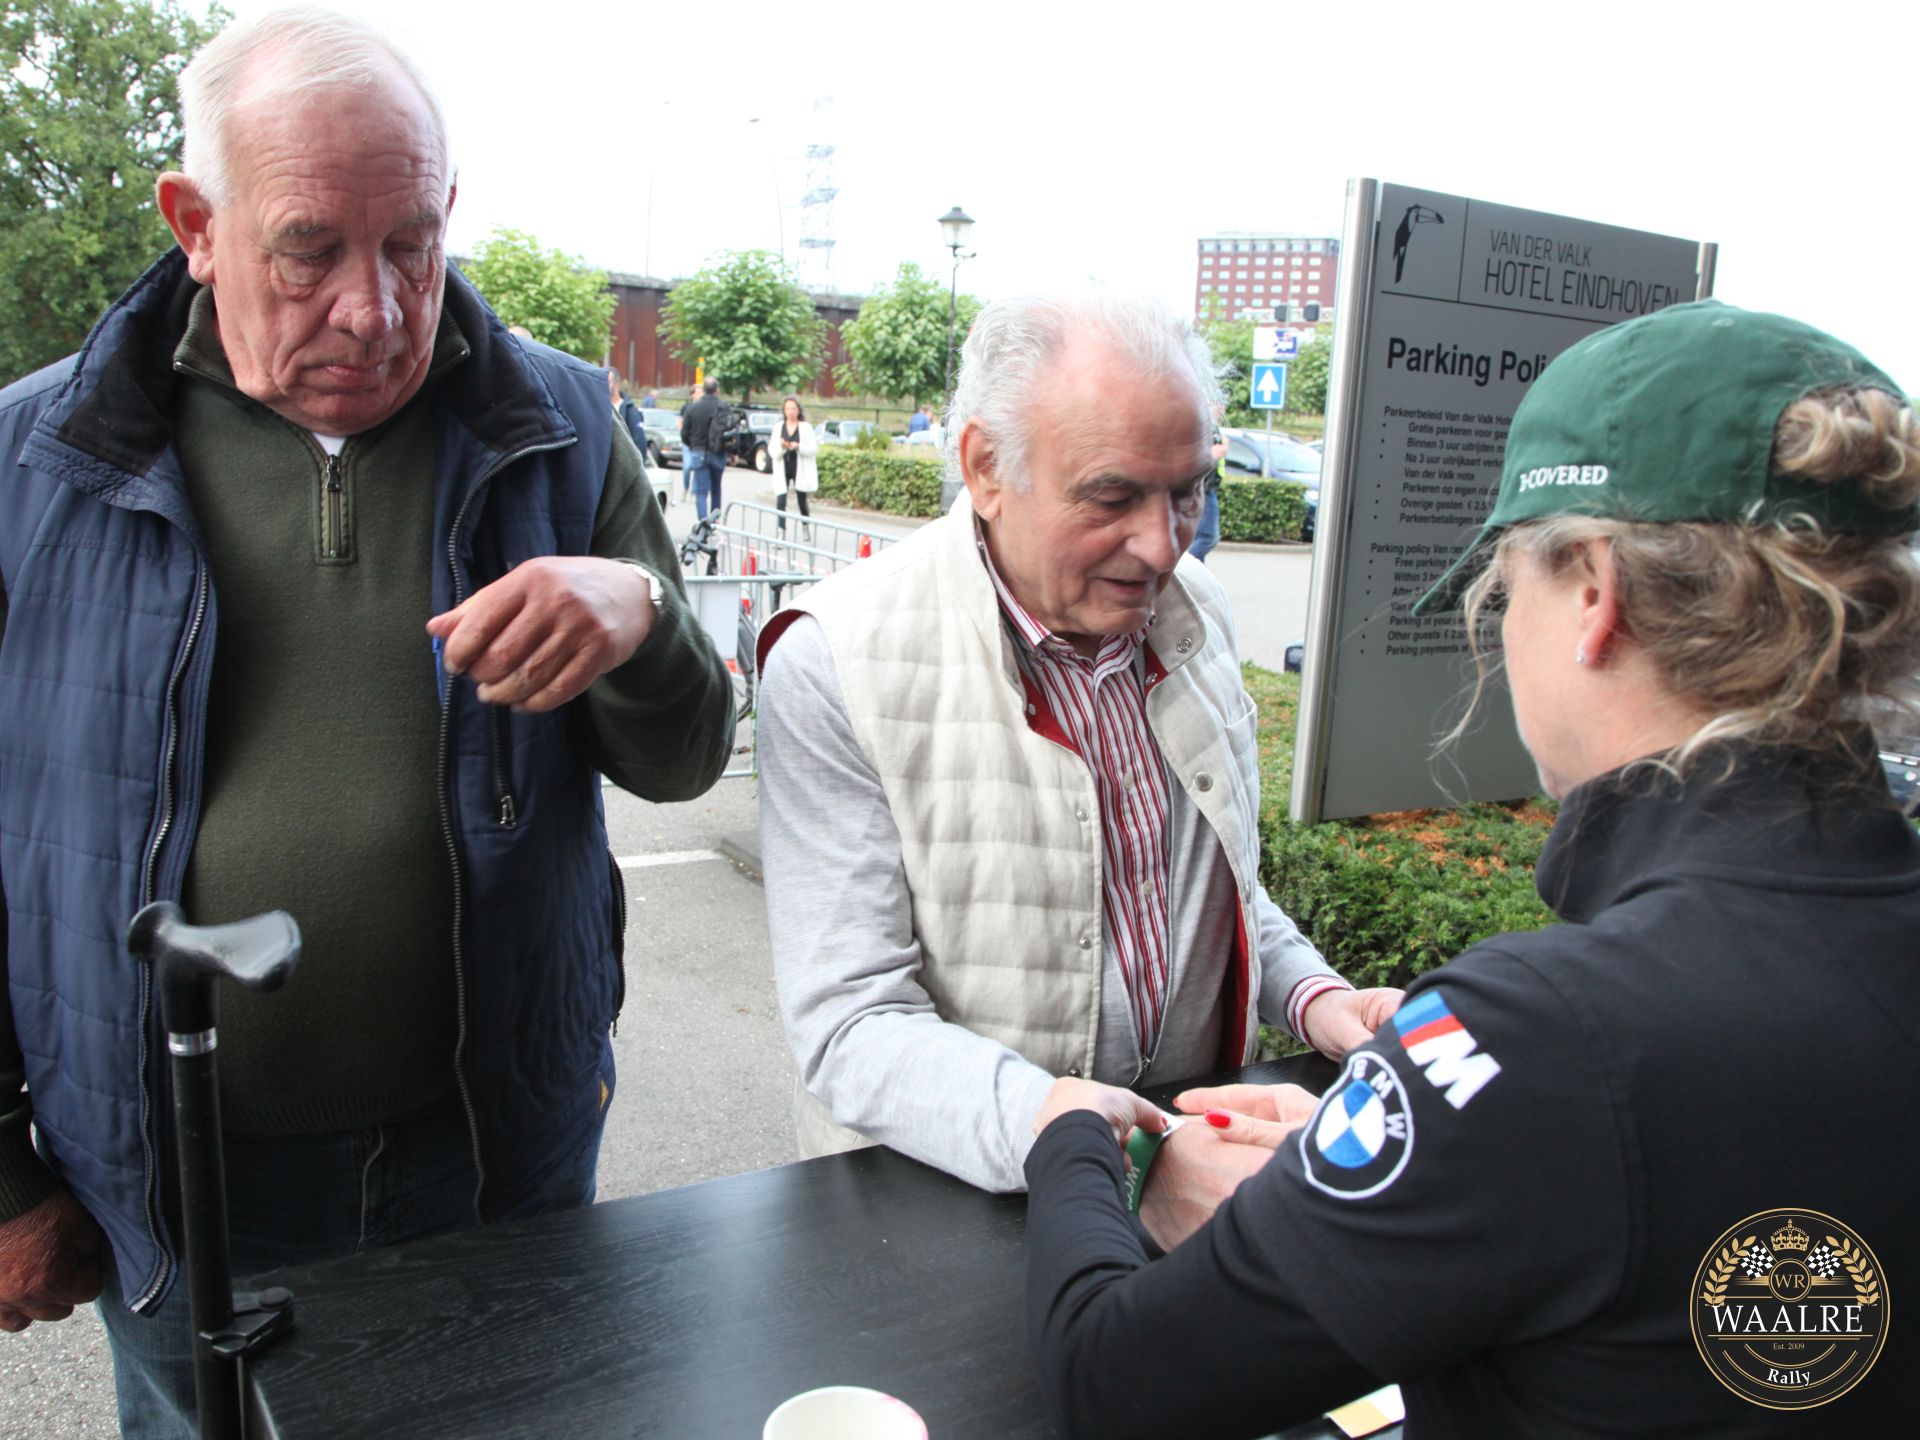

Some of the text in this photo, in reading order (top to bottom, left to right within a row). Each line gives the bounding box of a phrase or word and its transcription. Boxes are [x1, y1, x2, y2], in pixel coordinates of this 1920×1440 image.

[1491, 229, 1592, 267] VAN DER VALK
[1484, 258, 1555, 302] HOTEL
[1387, 337, 1491, 387] Parking
[1384, 405, 1443, 421] Parkeerbeleid
[1445, 410, 1460, 422] Van
[1462, 412, 1475, 423] der
[1477, 413, 1493, 425] Valk
[1408, 422, 1434, 434] Gratis
[1436, 423, 1473, 437] parkeren
[1474, 429, 1492, 438] voor
[1407, 437, 1437, 449] Binnen
[1439, 440, 1444, 450] 3
[1446, 442, 1460, 450] uur
[1462, 441, 1495, 454] uitrijden
[1405, 452, 1417, 463] Na
[1419, 453, 1425, 464] 3
[1426, 456, 1440, 464] uur
[1404, 467, 1419, 478] Van
[1422, 468, 1436, 479] der
[1438, 469, 1454, 480] Valk
[1402, 482, 1440, 493] Parkeren
[1442, 486, 1453, 496] op
[1455, 485, 1477, 497] eigen
[1401, 497, 1433, 510] Overige
[1435, 500, 1463, 511] gasten
[1399, 512, 1473, 526] Parkeerbetalingen
[1371, 542, 1404, 555] Parking
[1405, 543, 1430, 556] policy
[1433, 543, 1448, 553] Van
[1395, 557, 1413, 567] Free
[1415, 557, 1446, 569] parking
[1394, 572, 1420, 582] Within
[1423, 572, 1428, 582] 3
[1389, 616, 1421, 627] Parking
[1387, 630, 1410, 641] Other
[1413, 630, 1441, 643] guests
[1386, 645, 1418, 657] Parking
[1420, 644, 1459, 656] payments
[1352, 1058, 1406, 1140] BMW
